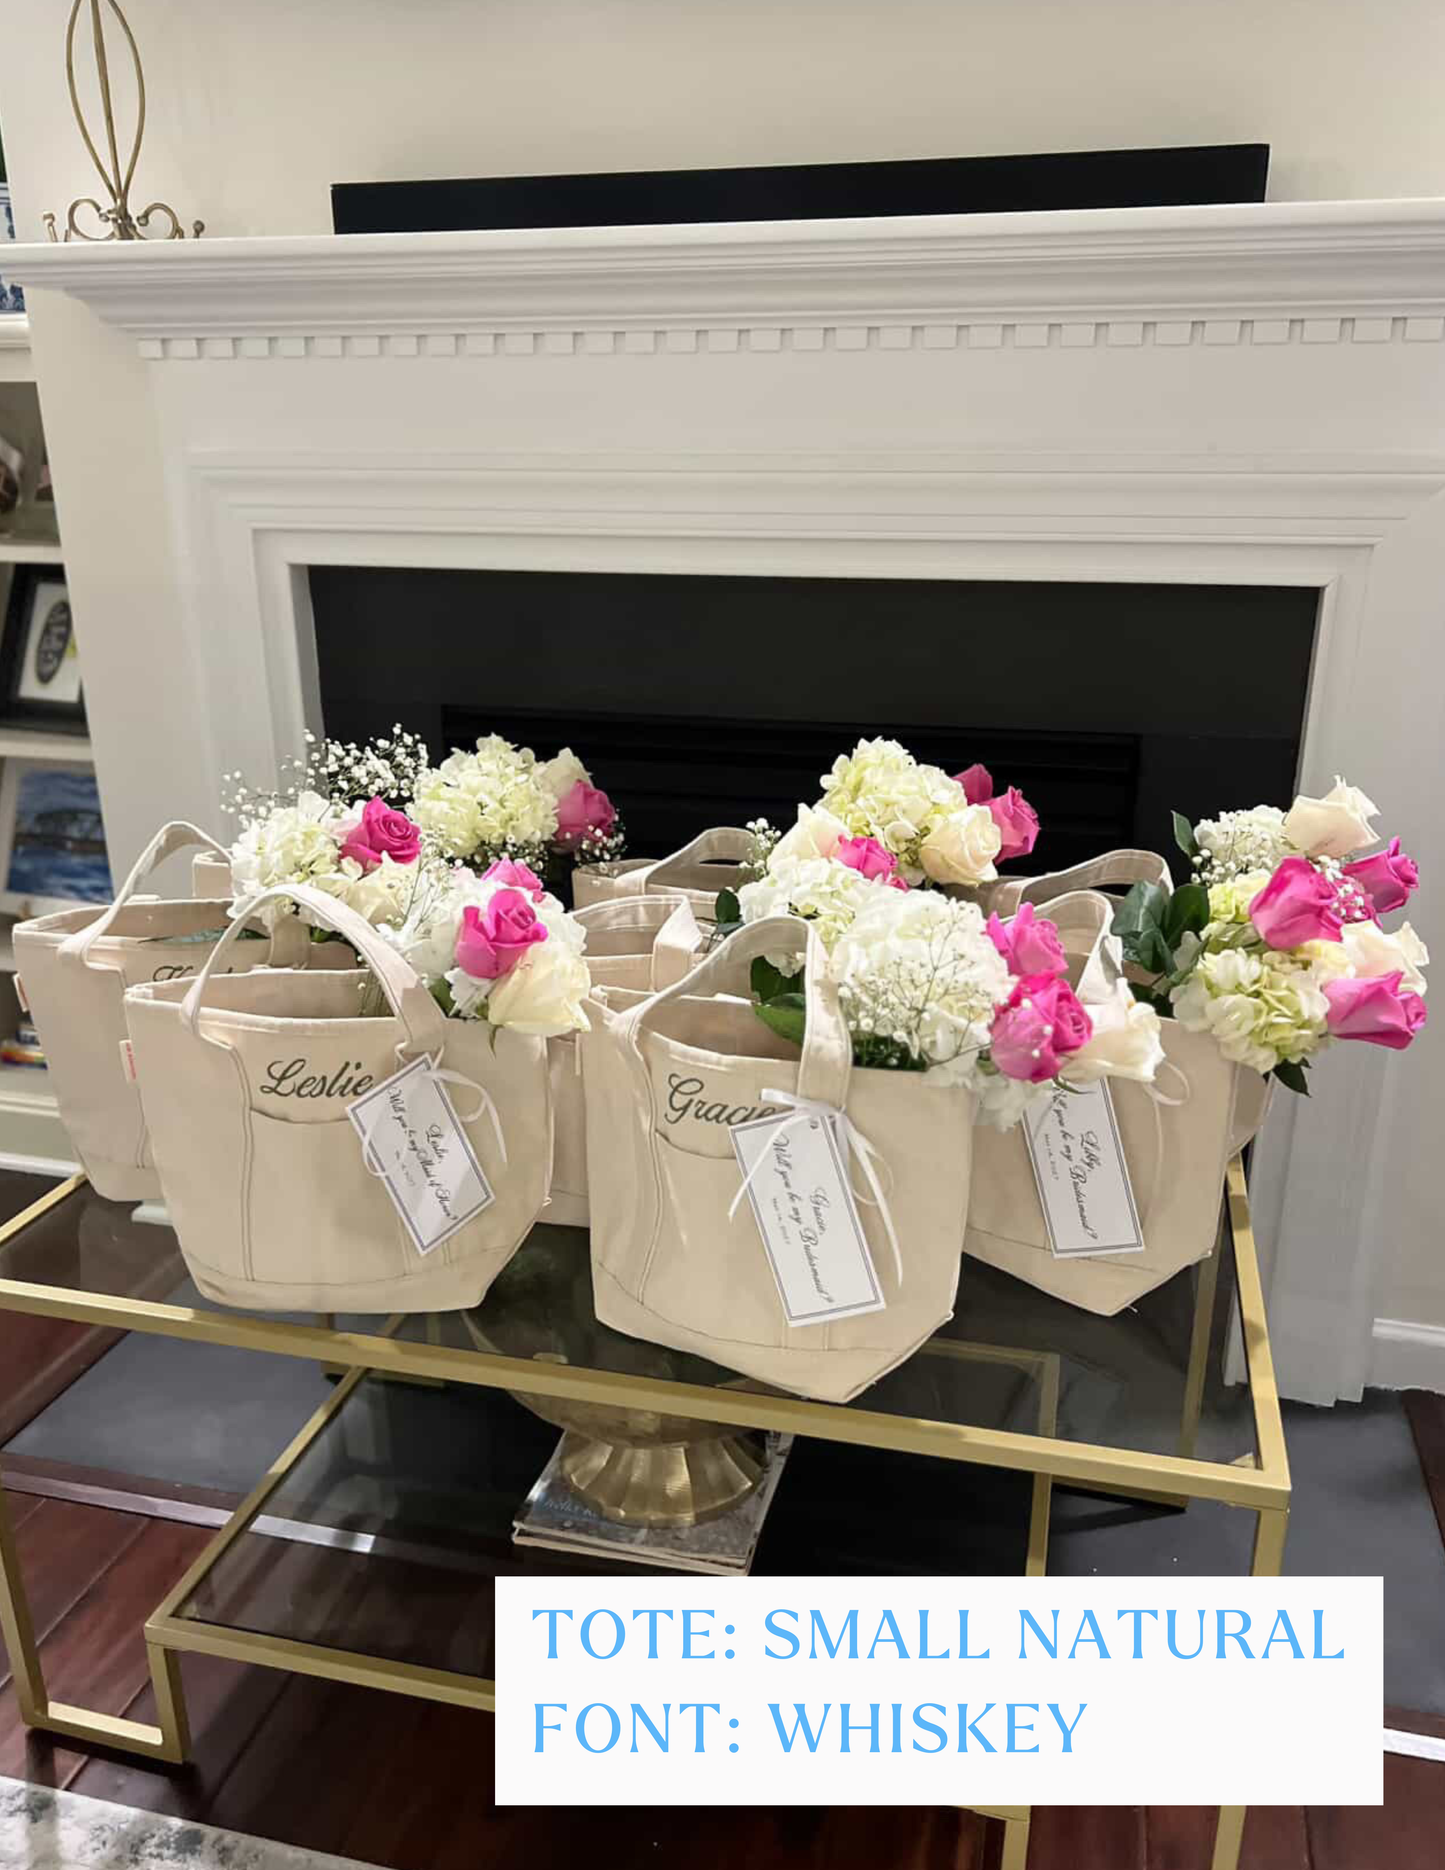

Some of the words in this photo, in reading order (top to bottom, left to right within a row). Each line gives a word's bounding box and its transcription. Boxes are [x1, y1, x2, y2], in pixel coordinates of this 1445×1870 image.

[260, 1059, 374, 1098] Leslie
[664, 1073, 776, 1126] Gracie
[773, 1134, 792, 1171] Will
[1053, 1109, 1066, 1127] you
[1060, 1144, 1073, 1162] my
[774, 1167, 791, 1189] you
[788, 1206, 803, 1225] my
